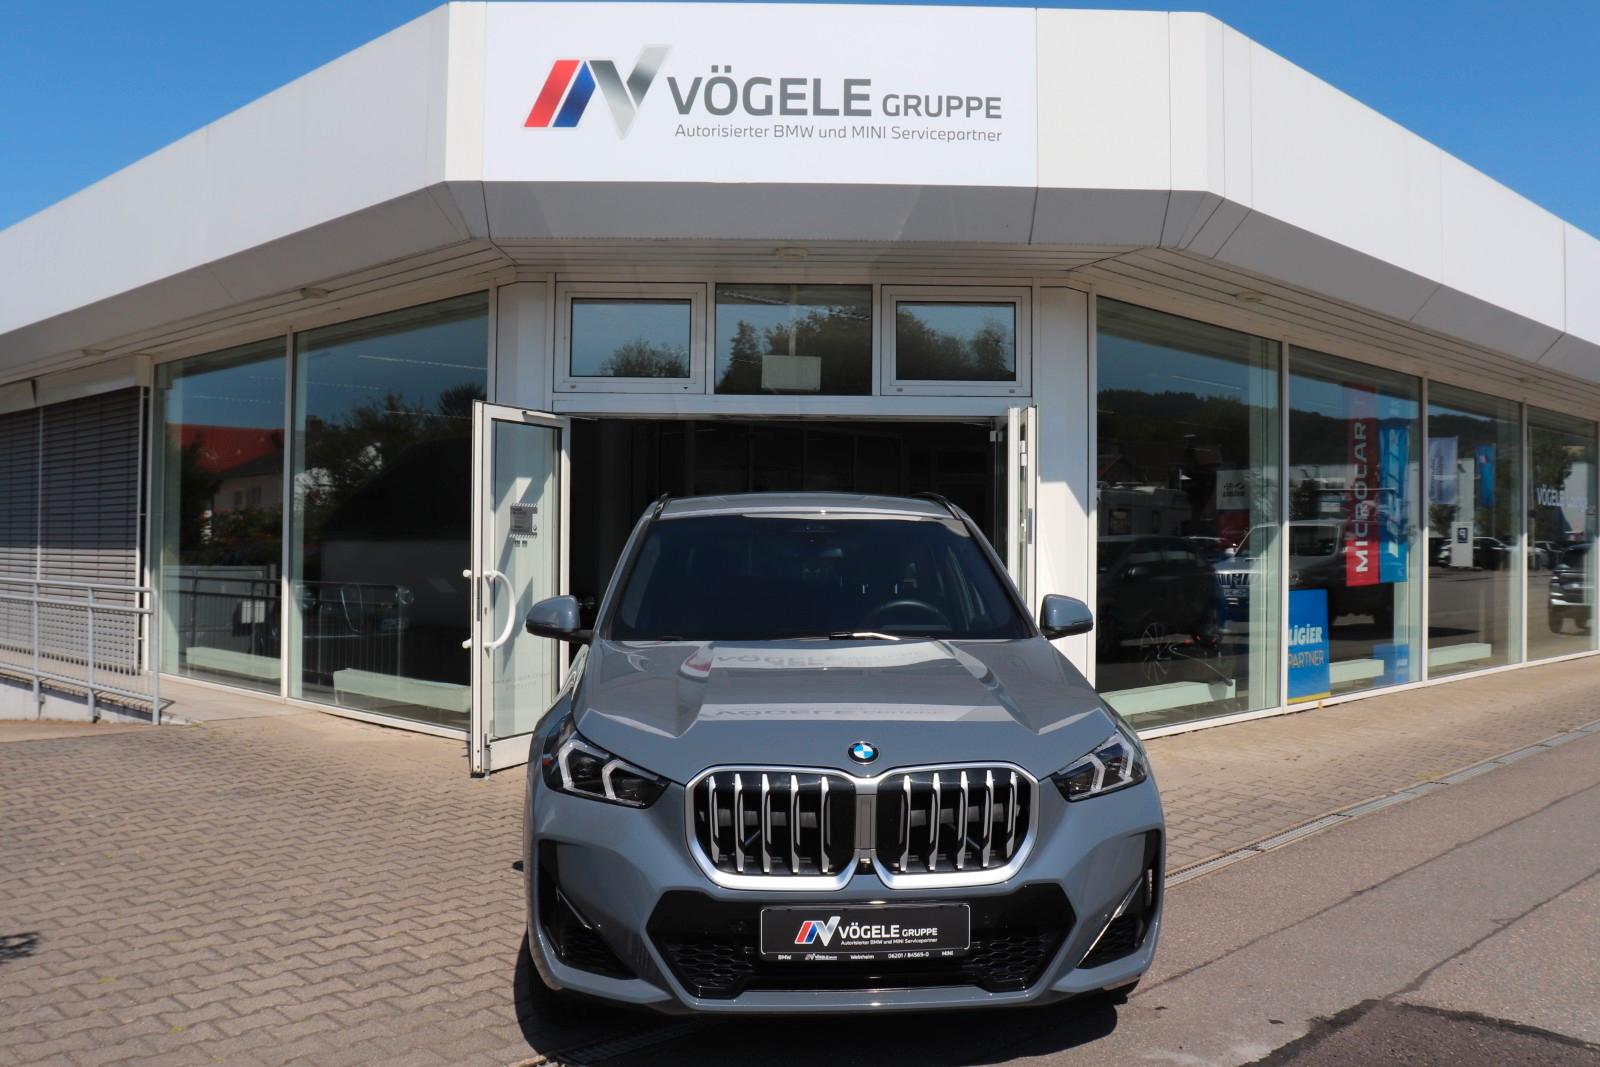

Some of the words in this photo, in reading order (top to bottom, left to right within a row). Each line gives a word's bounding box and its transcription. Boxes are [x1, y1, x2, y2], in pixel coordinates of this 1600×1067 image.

[666, 64, 873, 117] VÖGELE
[882, 93, 1003, 119] GRUPPE
[675, 124, 770, 139] Autorisierter
[774, 125, 815, 139] BMW
[818, 126, 848, 140] und
[852, 126, 887, 140] MINI
[892, 126, 1003, 143] Servicepartner
[1354, 421, 1369, 573] MICROCAR
[838, 922, 900, 939] VÖGELE
[902, 927, 938, 937] GRUPPE
